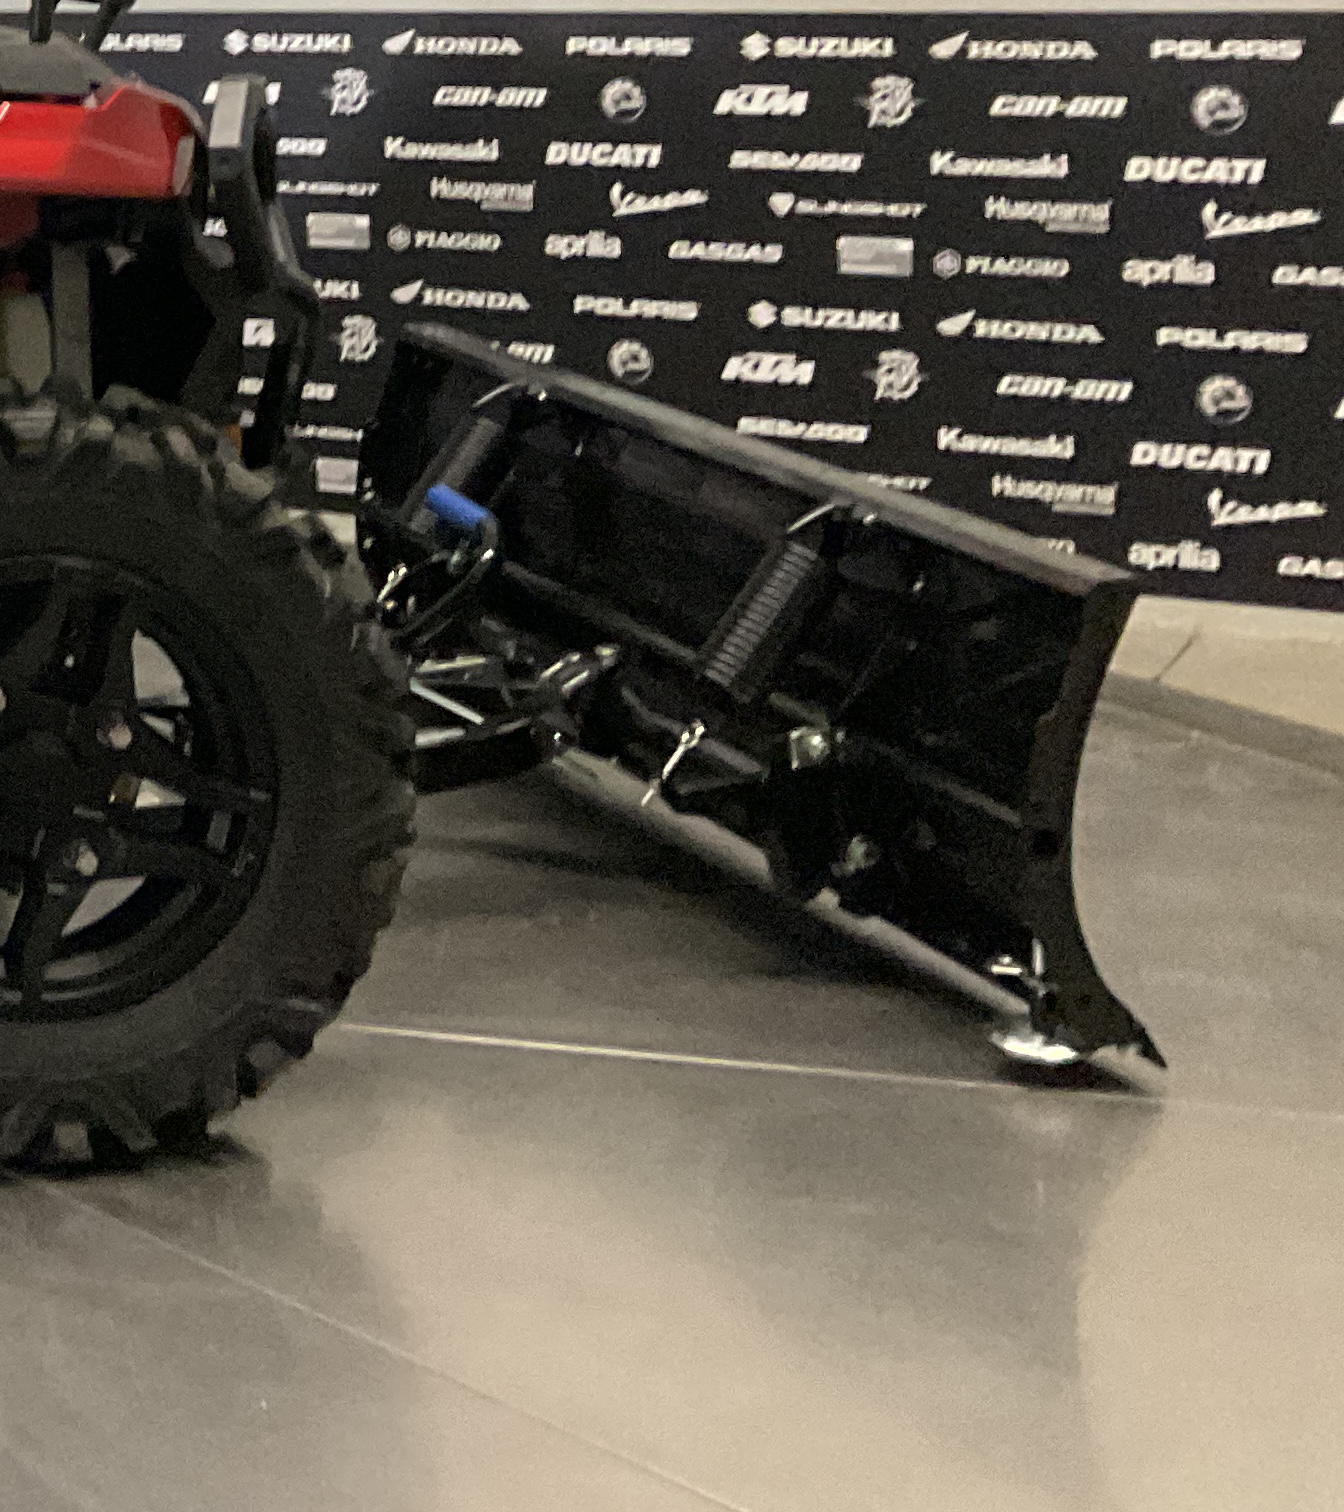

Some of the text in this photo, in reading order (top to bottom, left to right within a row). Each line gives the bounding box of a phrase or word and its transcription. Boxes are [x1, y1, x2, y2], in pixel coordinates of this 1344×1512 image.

[99, 32, 186, 53] OLARIS
[250, 32, 354, 54] SUZUKI
[412, 35, 524, 56] HONDA
[565, 35, 694, 57] POLARIS
[773, 36, 896, 59] SUZUKI
[966, 39, 1099, 61] HONDA
[1149, 38, 1306, 61] POLARIS
[432, 85, 548, 108] can-am
[712, 83, 809, 117] KTM
[988, 94, 1129, 119] can-am
[383, 135, 500, 162] Kawasaki
[544, 140, 663, 169] DUCATI
[929, 150, 1070, 179] Kawasaki
[1122, 155, 1267, 185] DUCATI
[544, 230, 622, 260] aprilia
[422, 287, 531, 311] HONDA
[573, 294, 699, 321] POLARIS
[780, 305, 901, 332] SUZUKI
[973, 318, 1105, 344] HONDA
[1155, 326, 1309, 354] POLARIS
[720, 351, 816, 386] KTM
[995, 373, 1134, 402] can-am
[937, 425, 1075, 460] Kawasaki
[1129, 440, 1272, 475] DUCATI
[1127, 539, 1221, 572] aprilia
